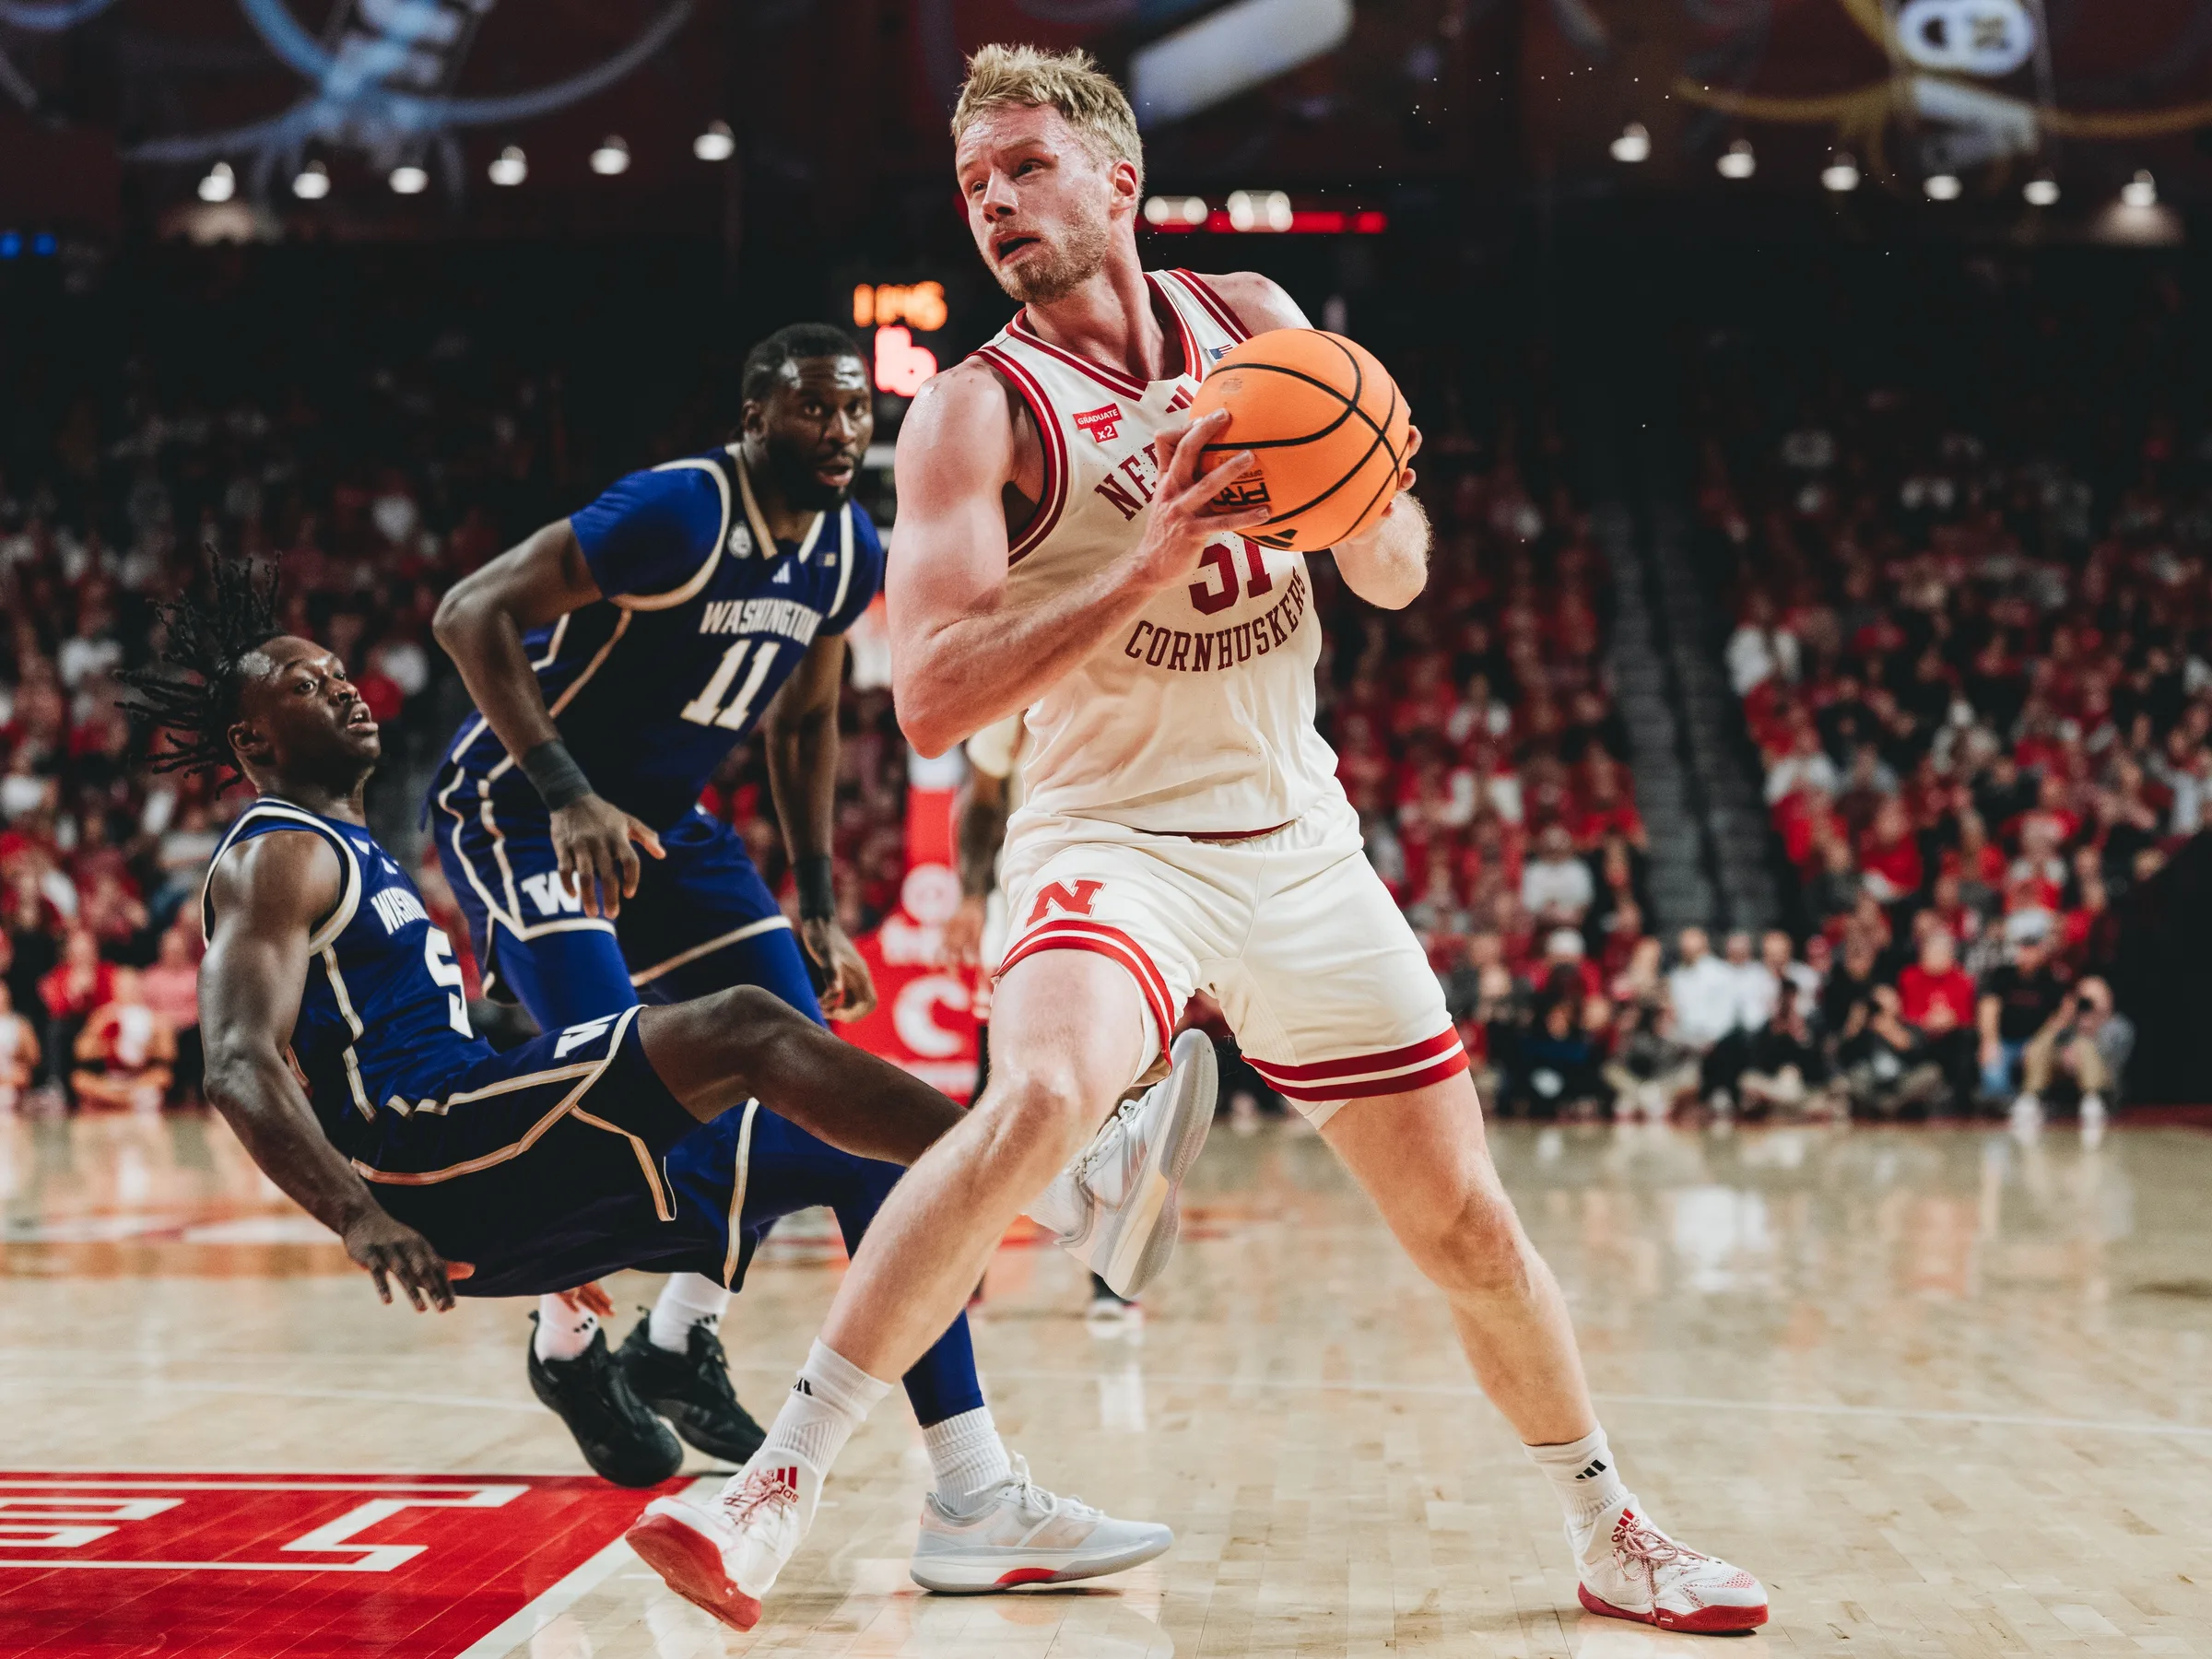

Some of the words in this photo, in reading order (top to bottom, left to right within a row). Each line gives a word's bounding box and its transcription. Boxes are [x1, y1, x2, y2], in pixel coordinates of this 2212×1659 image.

[1077, 408, 1119, 425] GRADUATE
[1097, 425, 1115, 440] x2
[699, 597, 824, 647] WASHINGTON
[1124, 566, 1306, 673] CORNHUSKERS
[679, 639, 782, 731] 11
[1024, 878, 1107, 931] N
[424, 925, 474, 1040] 5
